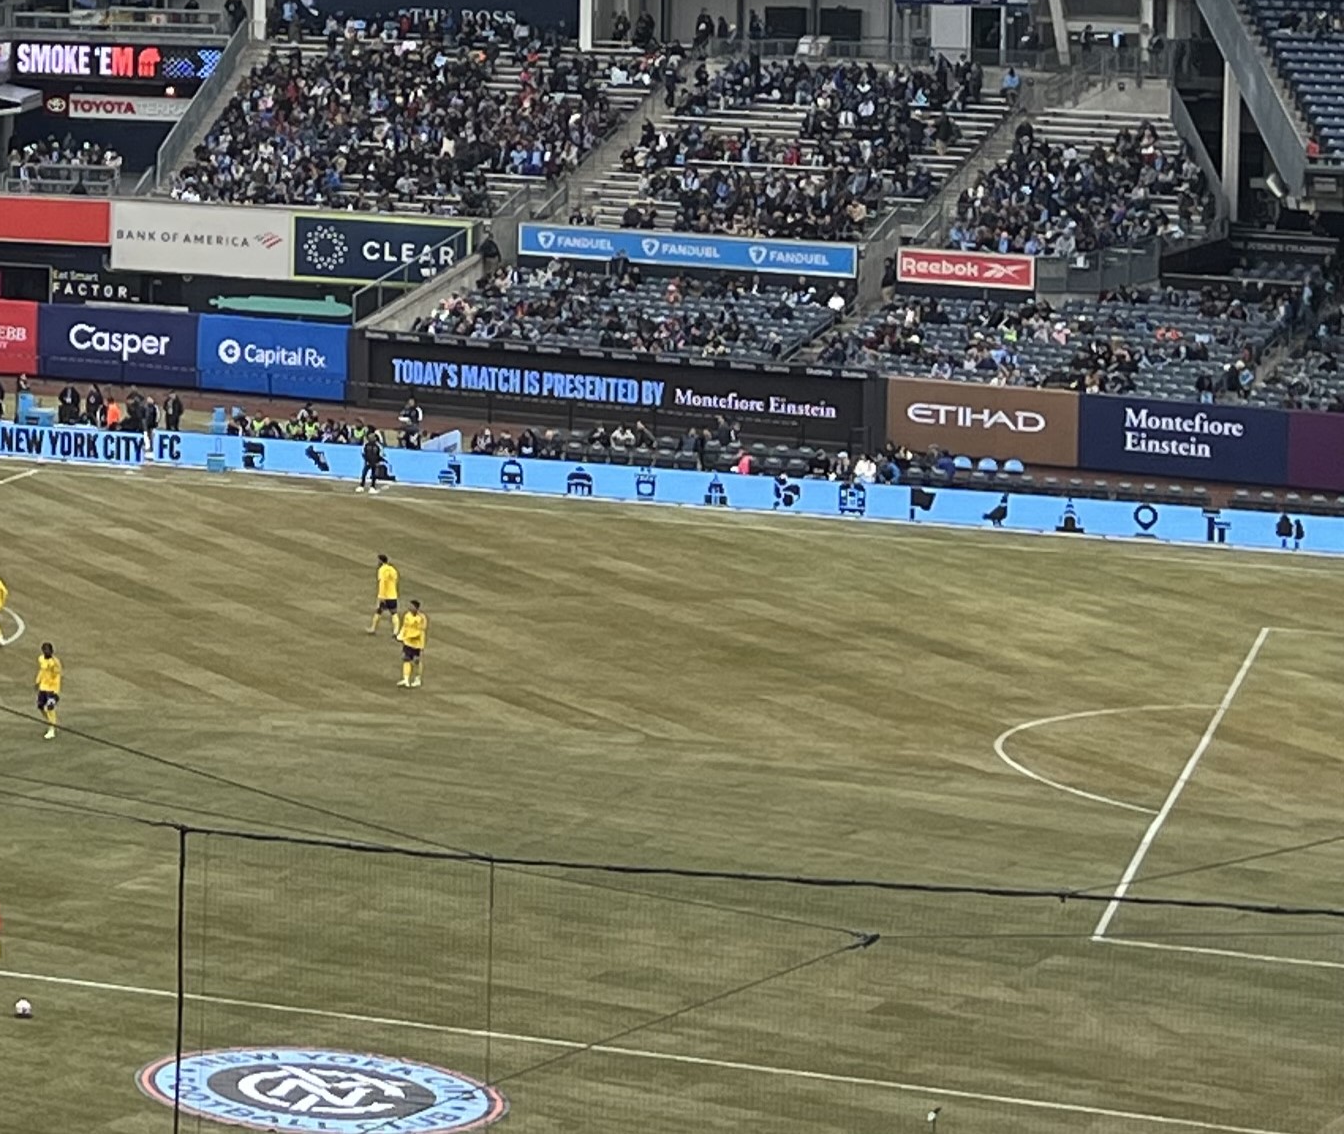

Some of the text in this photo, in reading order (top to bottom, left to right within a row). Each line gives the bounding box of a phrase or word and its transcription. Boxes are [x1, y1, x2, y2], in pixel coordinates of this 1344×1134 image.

[16, 42, 92, 76] SMOKE
[69, 98, 136, 117] TOYOTA
[116, 229, 250, 248] BANK OF AMERICA
[361, 239, 455, 267] CLEAR
[556, 235, 830, 266] FANDUEL FANDUEL FANDUEL
[901, 257, 980, 278] Reebok
[68, 322, 170, 360] Casper
[243, 342, 301, 368] Capital
[461, 363, 521, 394] MATCH
[523, 370, 540, 396] IS
[542, 371, 639, 403] PRESENTED
[642, 380, 665, 406] BY
[674, 387, 765, 413] Montefiore
[769, 396, 837, 419] Einstein
[906, 403, 1046, 433] ETIHAD
[1123, 406, 1245, 438] Montefiore
[0, 425, 182, 462] NEW YORK CITY FC
[1123, 431, 1213, 459] Einstein
